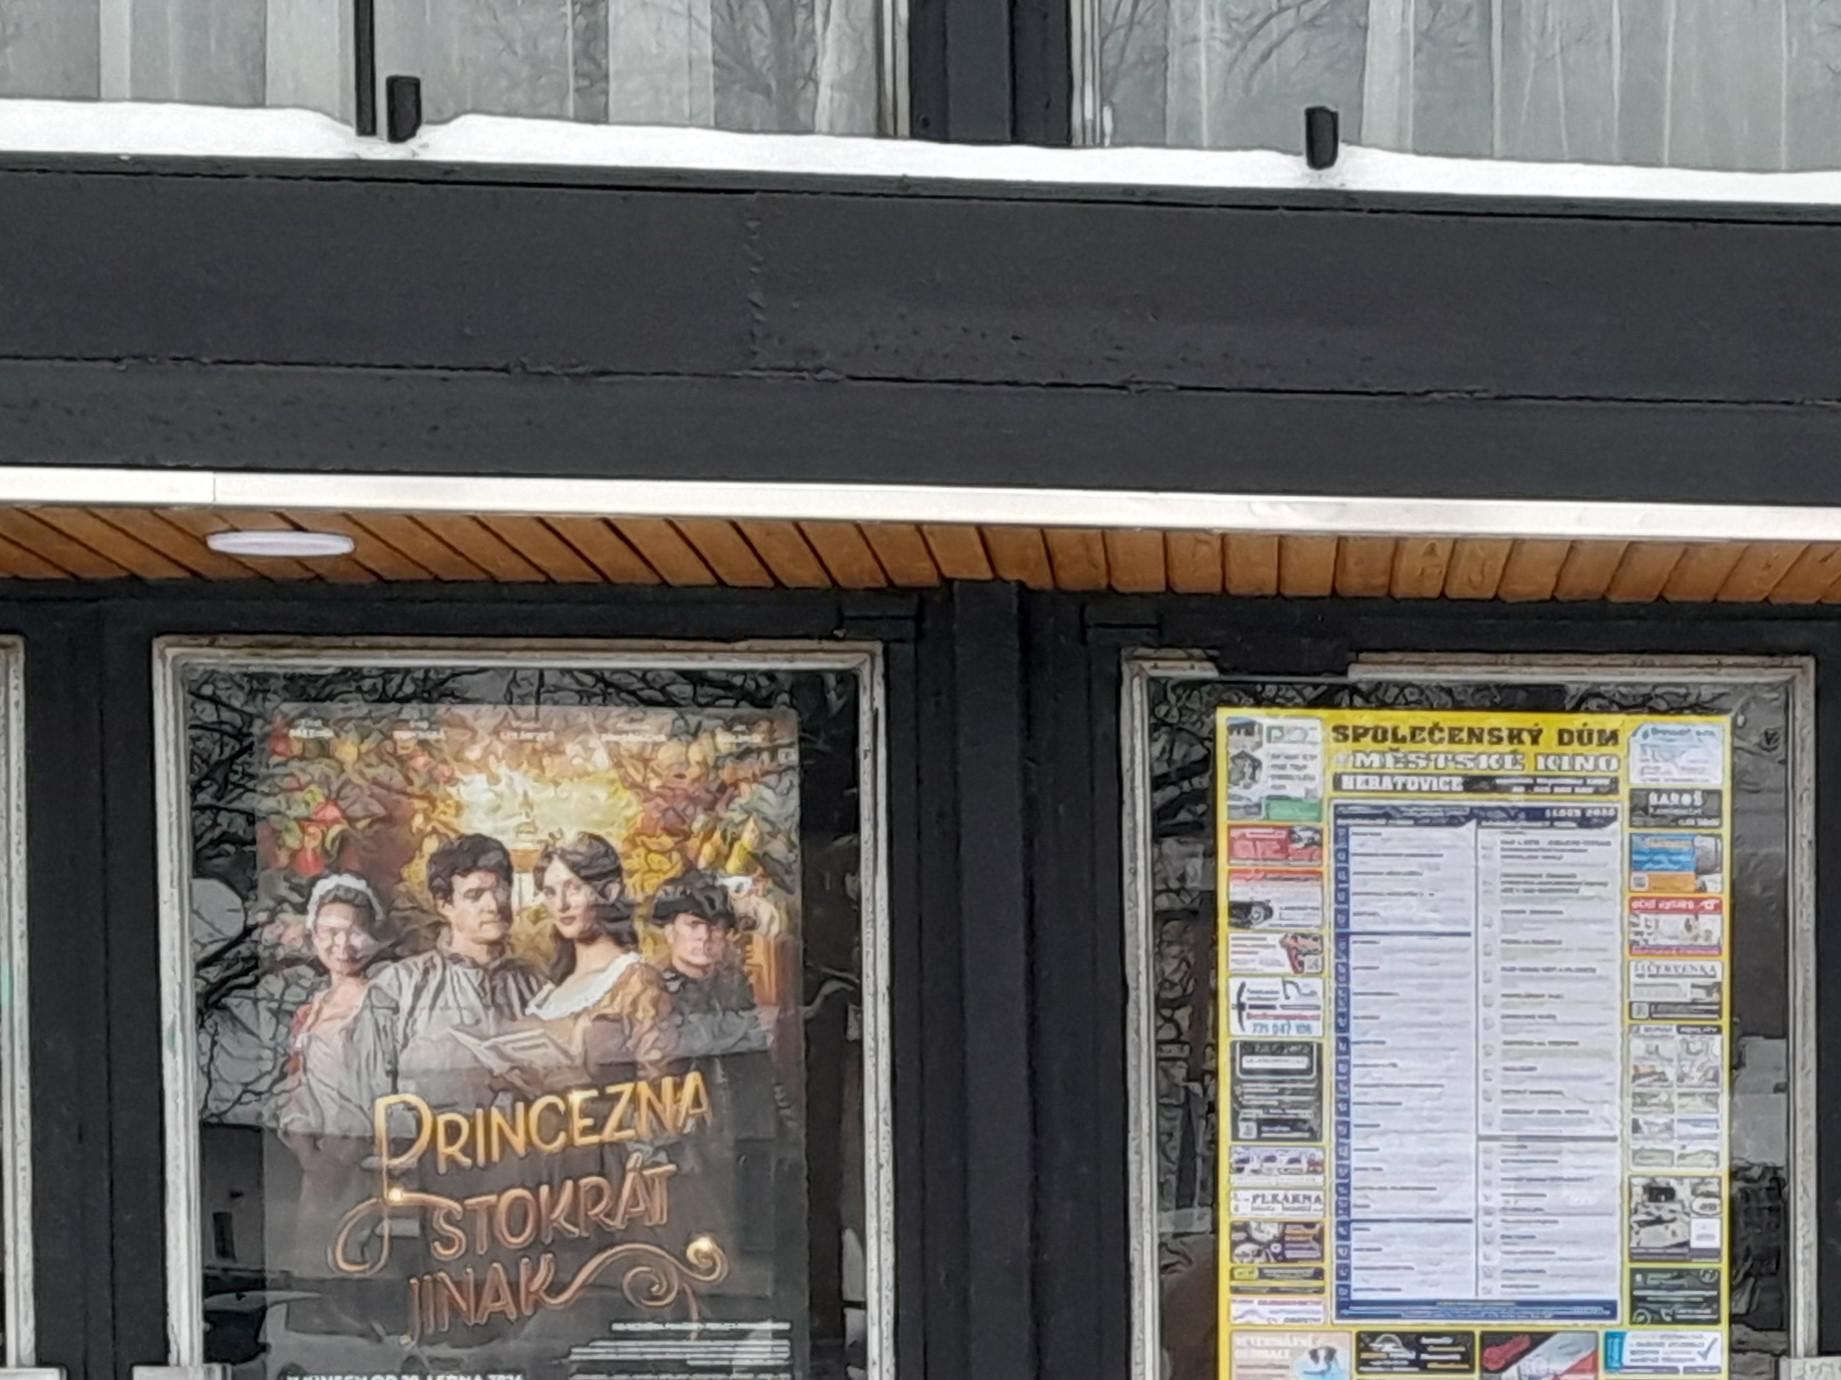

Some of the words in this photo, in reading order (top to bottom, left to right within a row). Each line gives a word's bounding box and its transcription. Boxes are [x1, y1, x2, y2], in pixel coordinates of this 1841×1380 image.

[1332, 722, 1543, 747] SPOLEČENSKÝ
[1557, 722, 1620, 747] DŮM
[1351, 749, 1526, 771] MĚSTSKÉ
[1535, 753, 1620, 772] KINO
[374, 1070, 712, 1178] PRINCEZNA
[431, 1152, 678, 1262] STOKRÁT
[400, 1253, 556, 1345] JINAK
